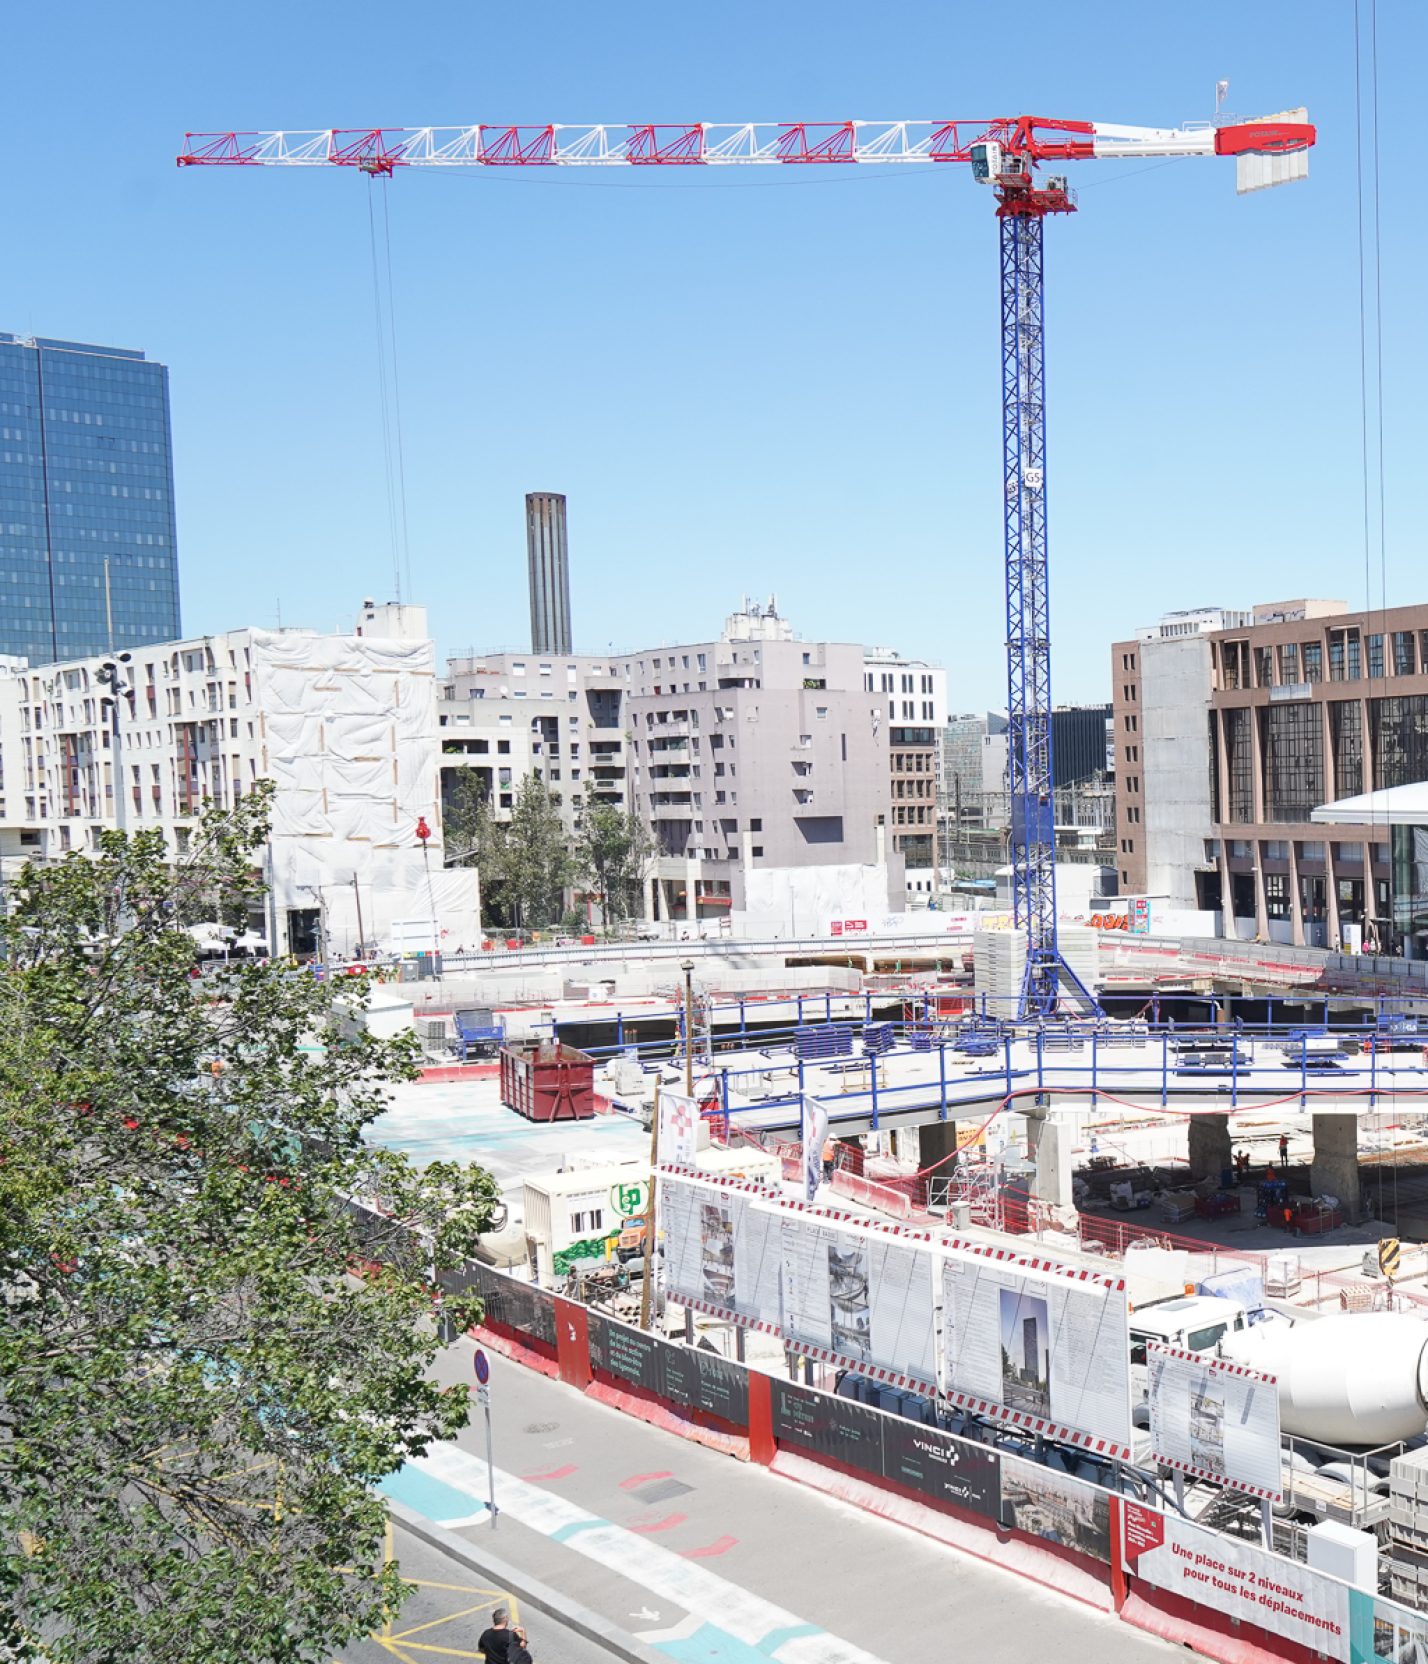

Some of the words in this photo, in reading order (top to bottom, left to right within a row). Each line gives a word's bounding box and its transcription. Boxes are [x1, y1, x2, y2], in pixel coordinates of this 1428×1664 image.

[1026, 472, 1041, 483] G5
[913, 1439, 945, 1457] VINCI
[1172, 1542, 1193, 1560] Une
[1195, 1551, 1225, 1573] place
[1228, 1566, 1246, 1580] sur
[1248, 1571, 1256, 1584] 2
[1258, 1577, 1304, 1602] niveaux
[1183, 1565, 1210, 1585] pour
[1212, 1577, 1237, 1594] tous
[1239, 1585, 1256, 1602] les
[1259, 1591, 1341, 1636] déplacements
